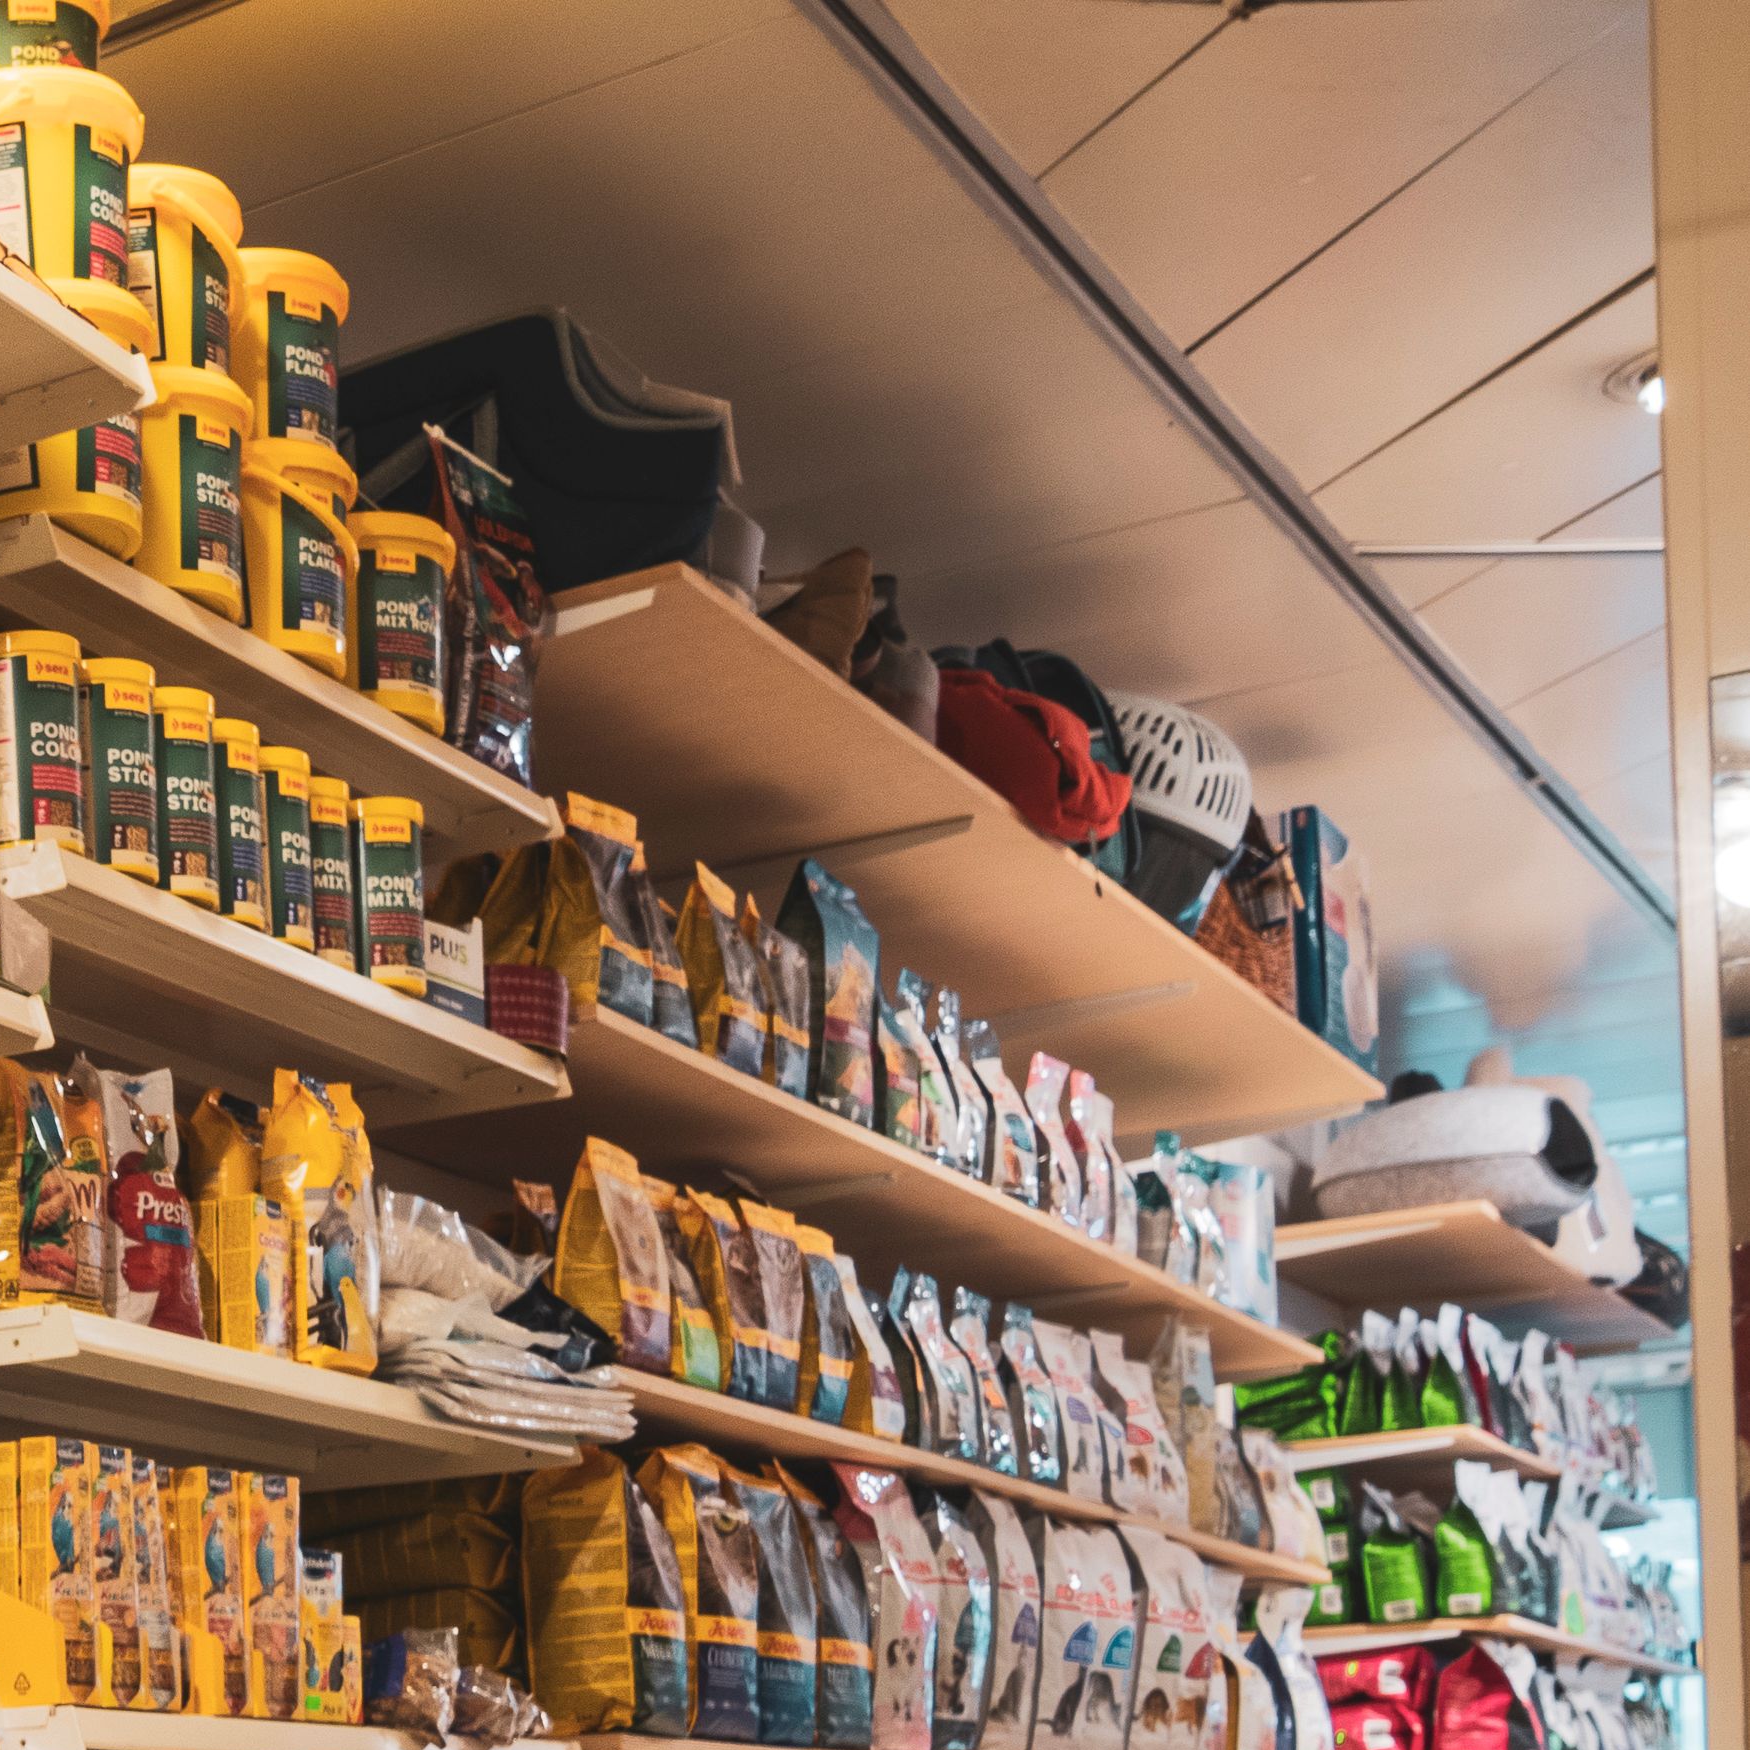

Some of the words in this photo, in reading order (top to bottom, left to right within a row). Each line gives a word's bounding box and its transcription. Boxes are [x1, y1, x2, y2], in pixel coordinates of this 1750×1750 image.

[11, 45, 60, 61] POND
[90, 185, 124, 214] POND
[285, 345, 324, 366] POND
[299, 536, 335, 558] POND
[376, 600, 418, 623] POND
[45, 663, 69, 676] sera
[30, 722, 79, 741] POND
[313, 873, 342, 890] MIX
[367, 876, 414, 894] POND
[428, 919, 469, 968] PLUS
